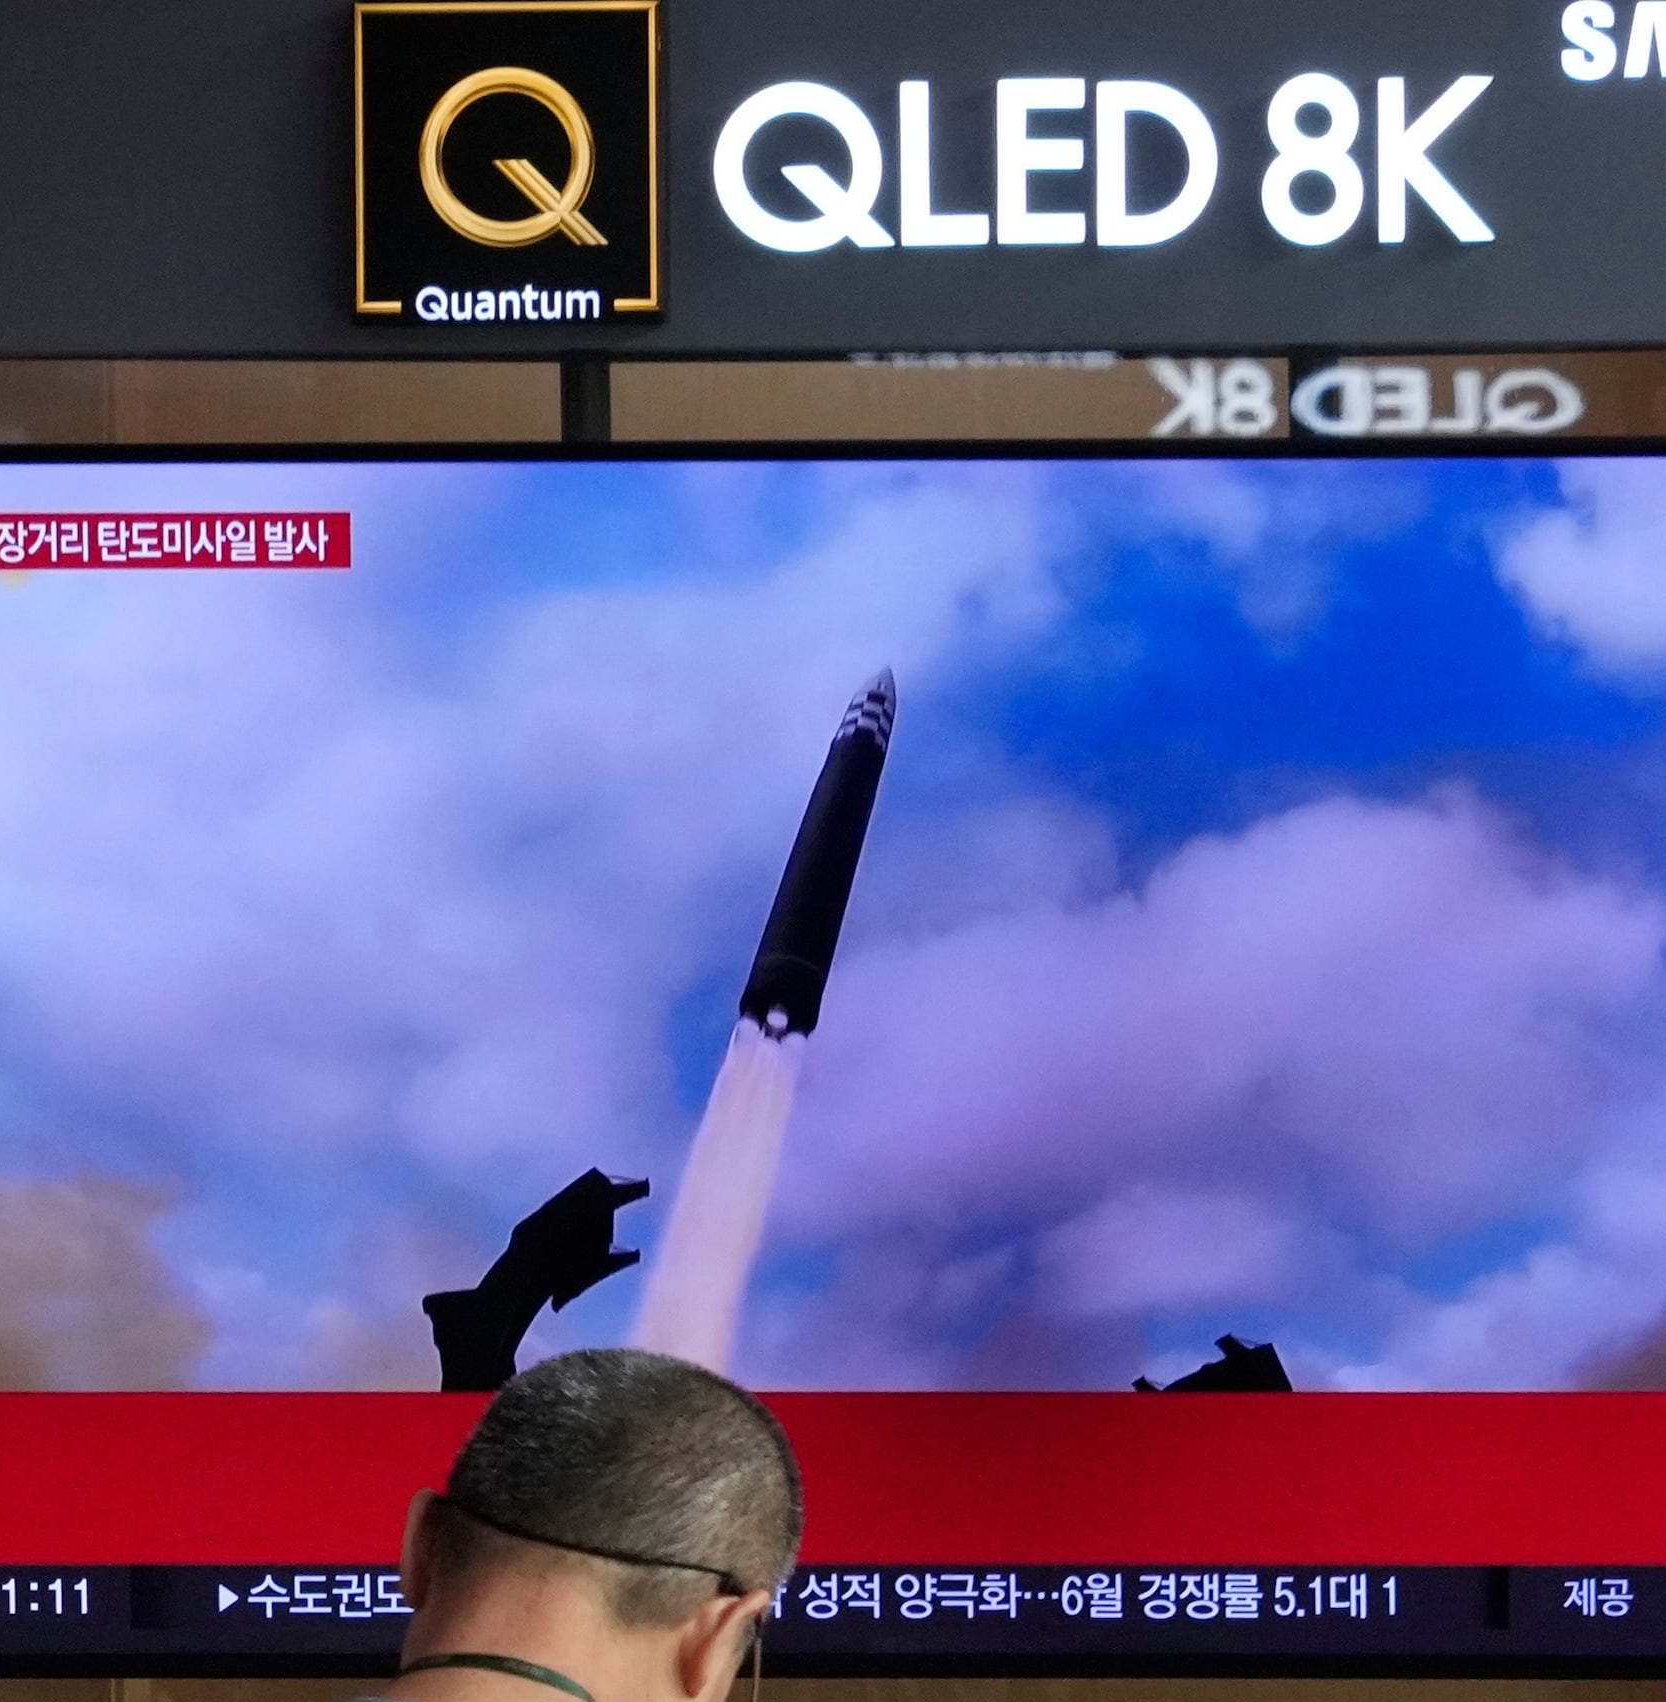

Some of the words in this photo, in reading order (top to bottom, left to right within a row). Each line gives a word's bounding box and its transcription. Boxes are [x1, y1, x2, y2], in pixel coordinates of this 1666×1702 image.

[419, 66, 608, 247] Q
[712, 78, 1219, 253] QLED
[1261, 73, 1496, 246] 8K
[415, 284, 600, 321] Quantum
[98, 520, 256, 562] 탄도미사일
[264, 519, 329, 562] 발사
[247, 1573, 416, 1618] 수도권도
[798, 1573, 881, 1619] 성적
[1137, 1573, 1264, 1618] 경쟁률
[1273, 1573, 1368, 1618] 5.1대
[1383, 1575, 1398, 1616] 1
[1564, 1578, 1634, 1616] 제공
